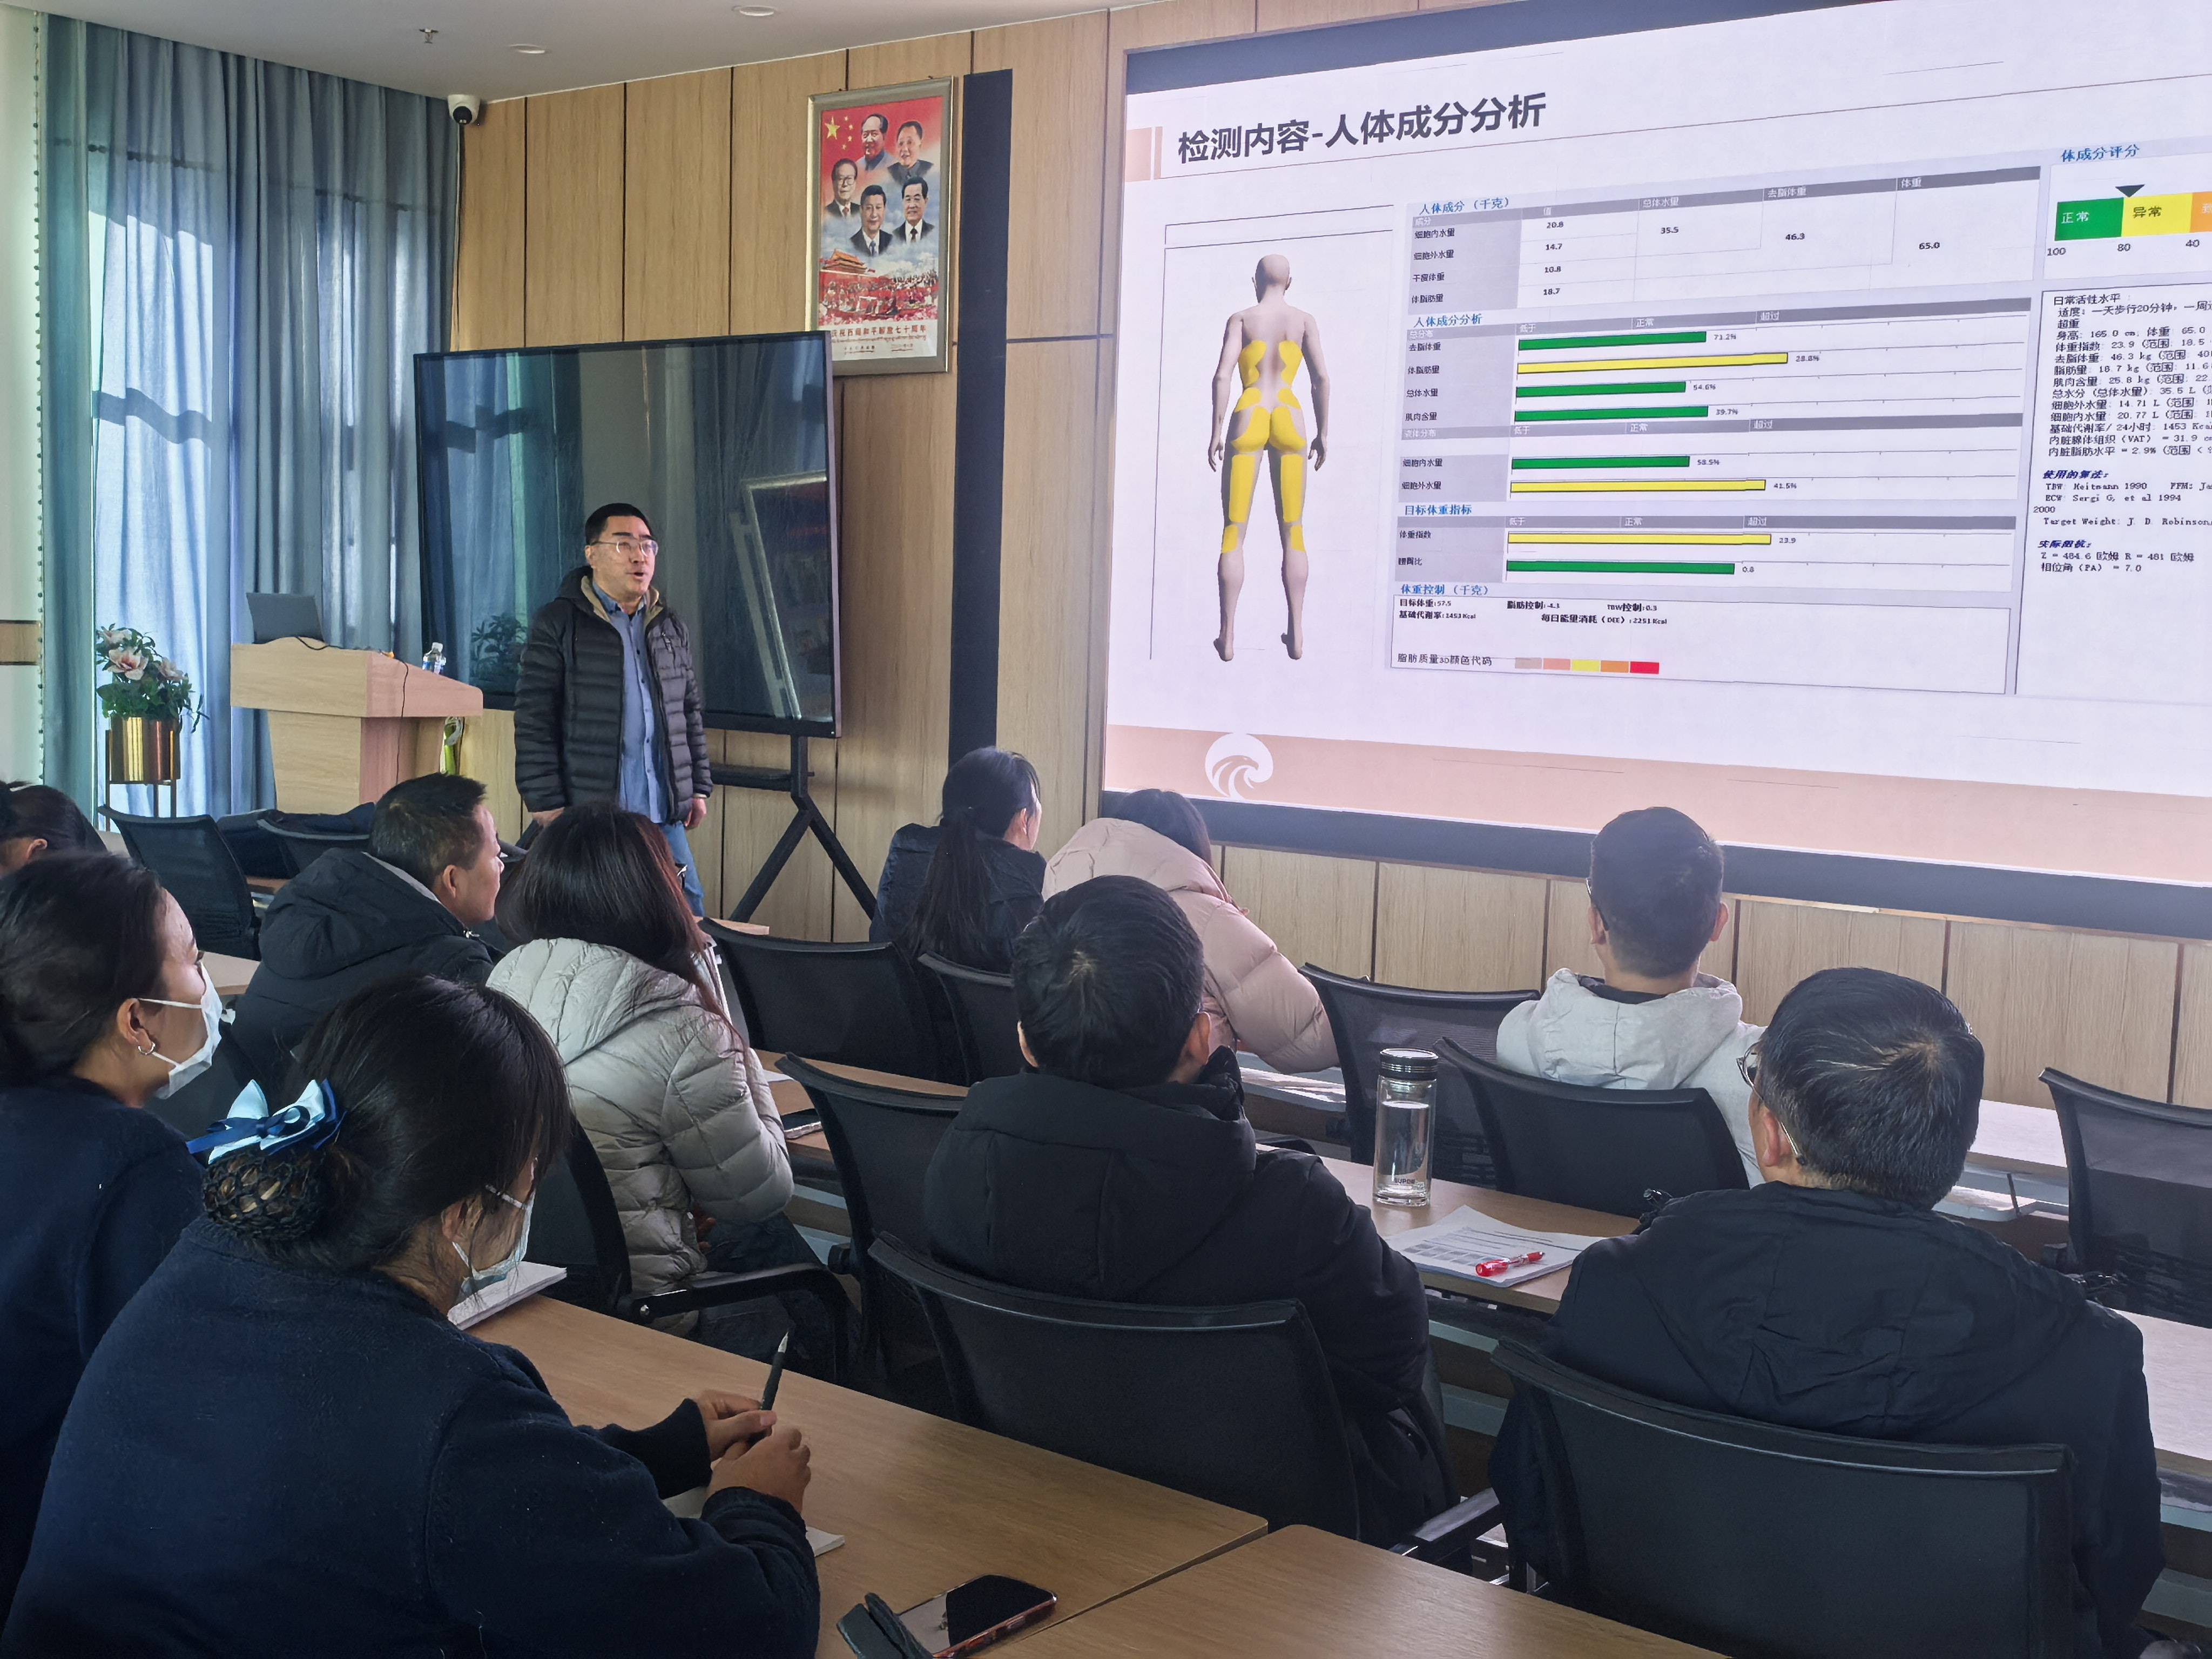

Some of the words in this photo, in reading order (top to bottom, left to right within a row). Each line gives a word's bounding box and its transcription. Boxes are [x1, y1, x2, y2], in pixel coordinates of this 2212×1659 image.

[1178, 91, 1547, 165] 检测内容-人体成分分析
[2061, 144, 2140, 162] 体成分评分
[2061, 211, 2089, 224] 正常
[2133, 206, 2162, 219] 异常
[1546, 221, 1564, 230] 20.8
[1661, 226, 1680, 235] 35.5
[1785, 233, 1805, 241] 46.3
[1545, 243, 1563, 252] 14.7
[1919, 242, 1940, 251] 65.0
[2047, 247, 2066, 257] 100
[2117, 244, 2131, 252] 80
[2186, 239, 2200, 247] 40
[1414, 313, 1482, 328] 人体成分分析
[1635, 317, 1654, 328] 正常
[2058, 319, 2079, 329] 超重
[2052, 389, 2085, 399] 总水分
[1405, 412, 1437, 422] 肌肉含量
[1630, 423, 1648, 433] 正常
[2048, 447, 2115, 457] 内脏脂肪水平
[1405, 504, 1472, 516] 目标体重指标
[1624, 517, 1642, 526] 正常
[1399, 530, 1431, 539] 体重指数
